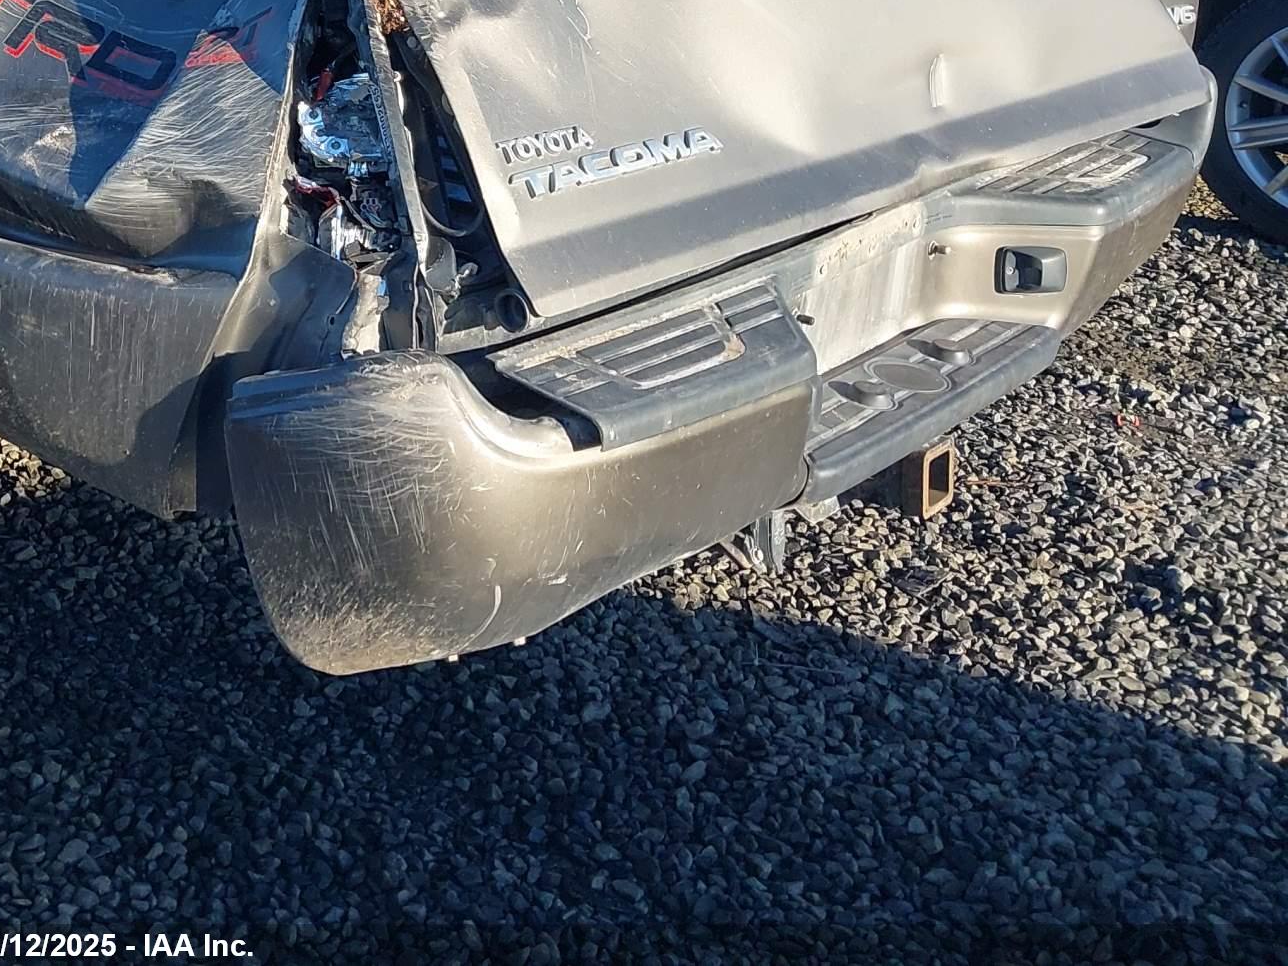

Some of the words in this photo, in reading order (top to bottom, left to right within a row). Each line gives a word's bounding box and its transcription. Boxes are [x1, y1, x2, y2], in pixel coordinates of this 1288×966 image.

[1167, 5, 1196, 24] V6
[496, 124, 595, 165] TOYOTA
[508, 127, 724, 199] TACOMA
